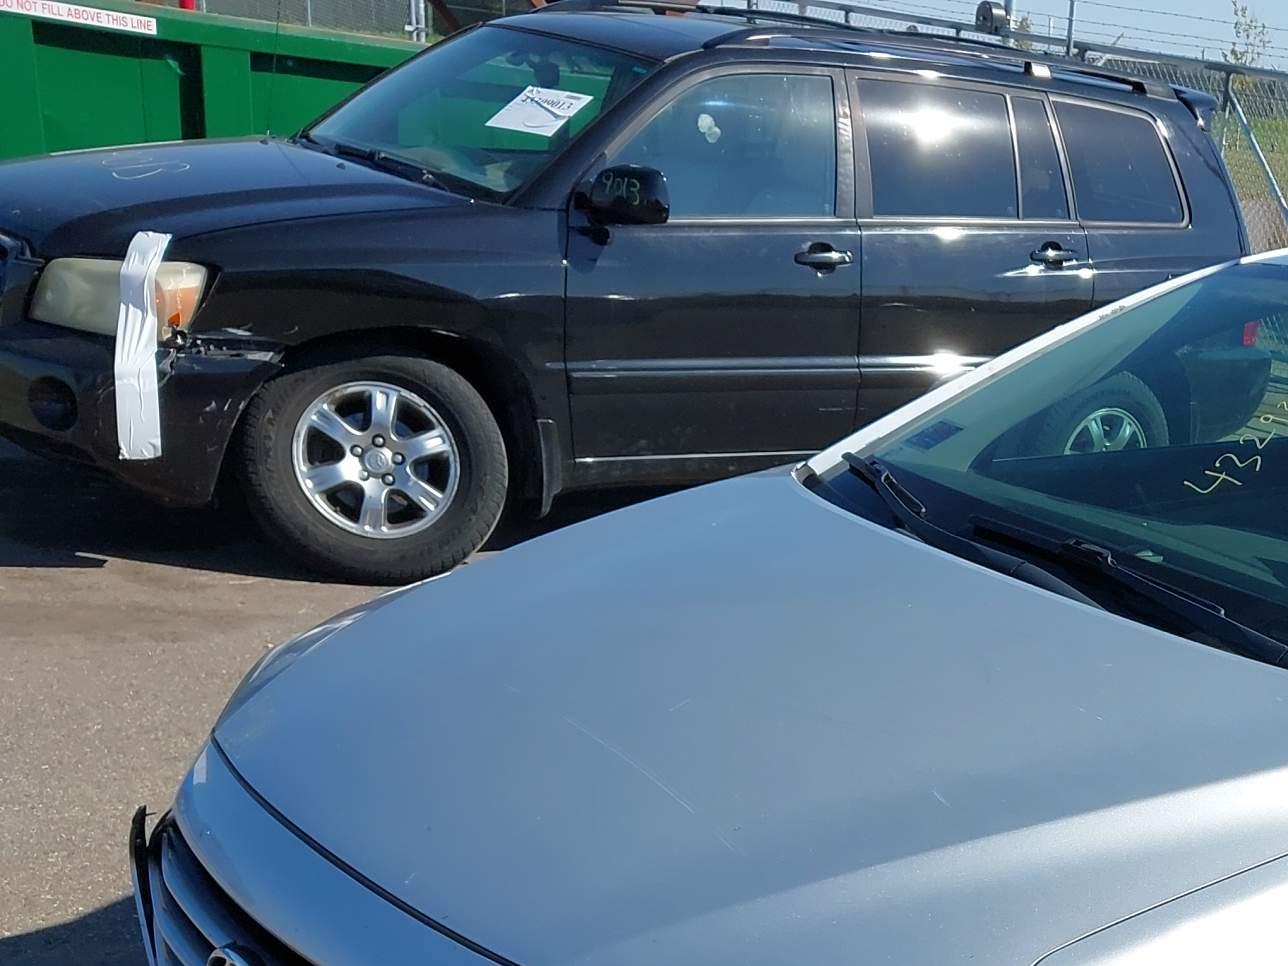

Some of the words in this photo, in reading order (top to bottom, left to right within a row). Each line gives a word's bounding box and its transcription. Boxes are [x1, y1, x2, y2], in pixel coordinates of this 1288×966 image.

[16, 0, 38, 12] NOT
[42, 3, 64, 17] FILL
[67, 7, 102, 23] ABOVE
[105, 13, 128, 27] THIS
[131, 18, 153, 31] LINE
[602, 171, 641, 206] 9013
